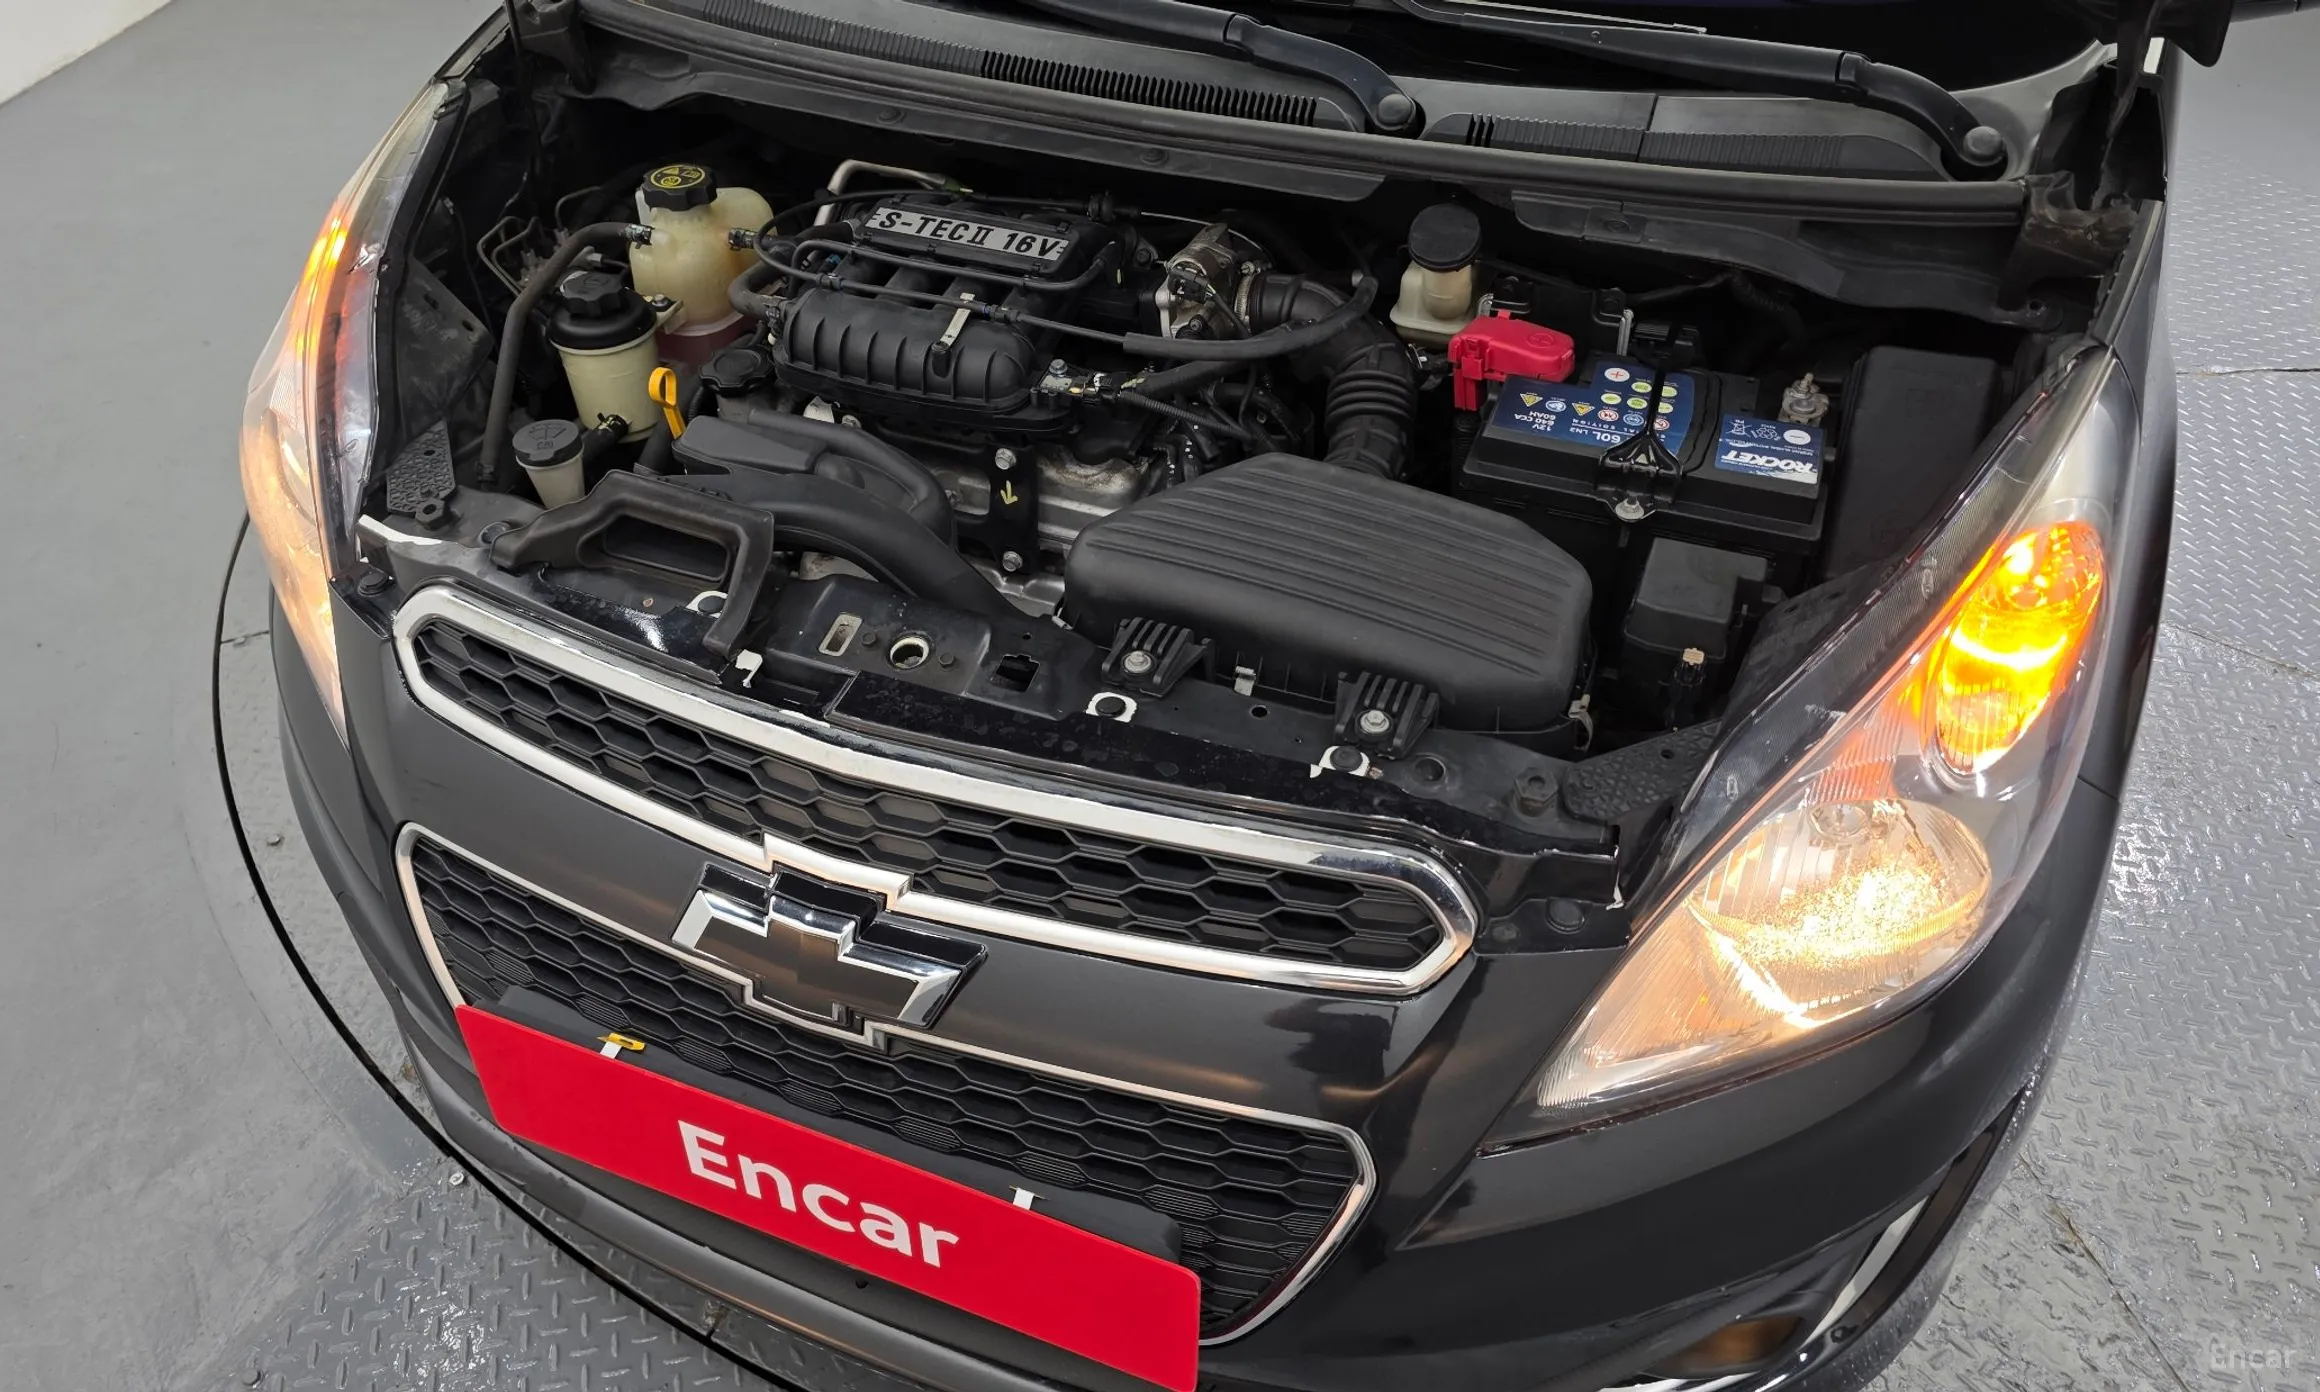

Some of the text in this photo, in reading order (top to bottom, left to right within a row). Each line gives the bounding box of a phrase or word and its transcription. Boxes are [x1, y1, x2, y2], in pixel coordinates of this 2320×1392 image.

[1001, 231, 1061, 258] 16V
[1514, 413, 1533, 422] CCA
[1529, 411, 1556, 420] 60AH
[1532, 422, 1552, 432] 12V
[1592, 431, 1621, 444] 60L
[1721, 450, 1814, 474] ROCKET
[677, 1119, 960, 1268] Encar
